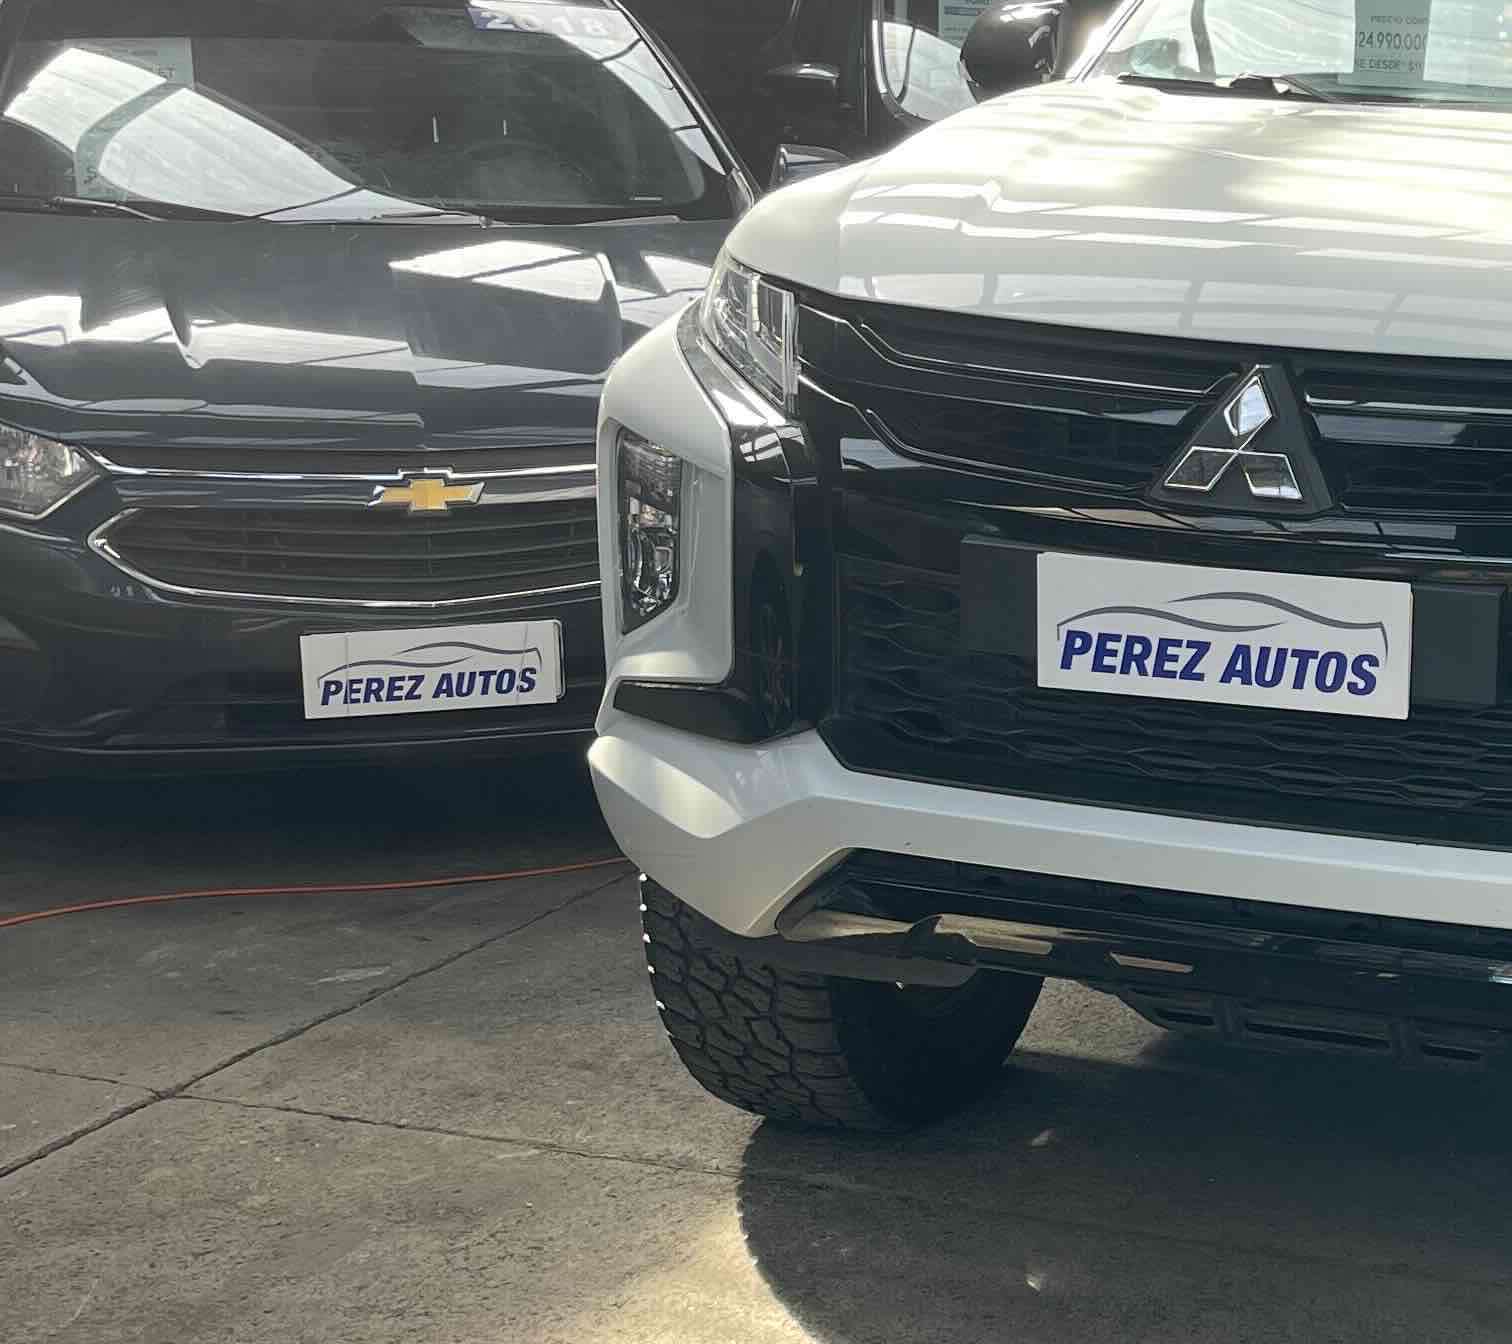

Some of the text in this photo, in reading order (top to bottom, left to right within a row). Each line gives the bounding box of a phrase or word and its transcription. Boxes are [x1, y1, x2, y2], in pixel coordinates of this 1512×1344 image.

[320, 666, 537, 706] PEREZ AUTOS
[1058, 628, 1381, 697] PEREZ AUTOS
